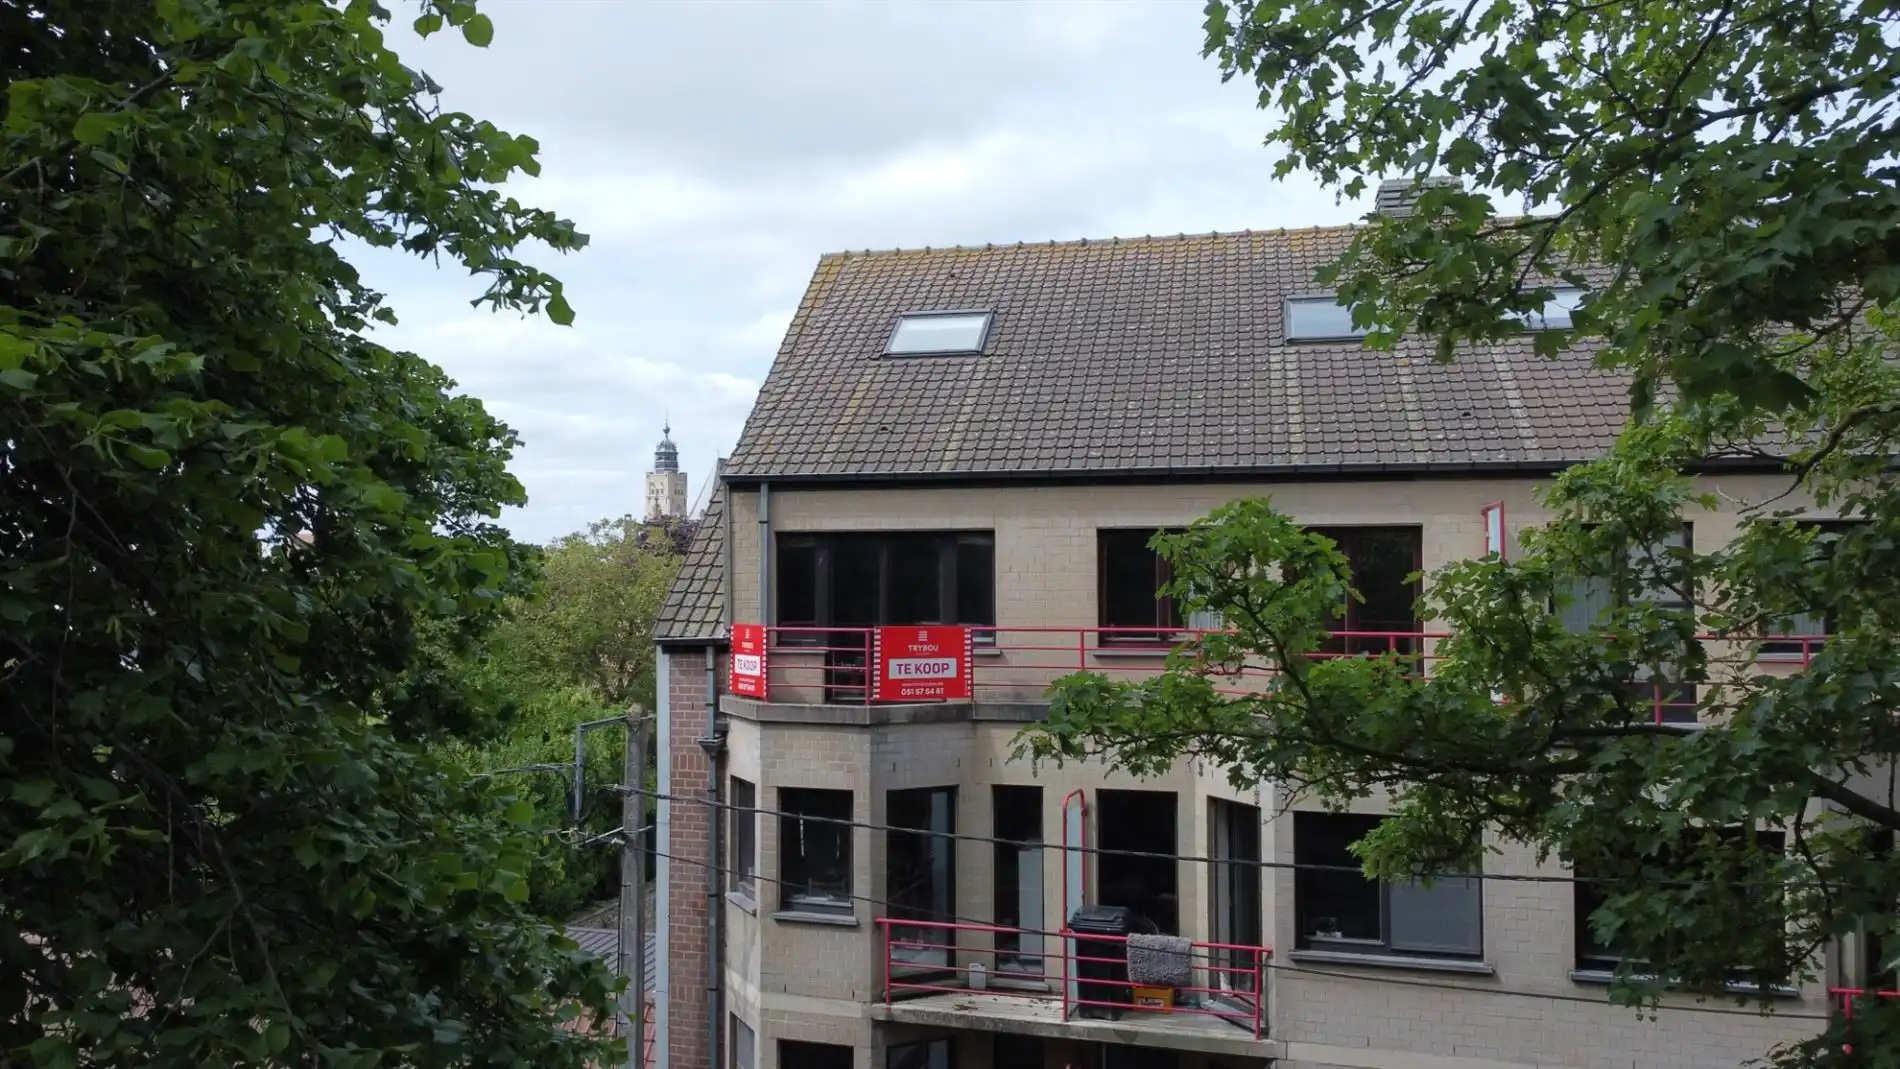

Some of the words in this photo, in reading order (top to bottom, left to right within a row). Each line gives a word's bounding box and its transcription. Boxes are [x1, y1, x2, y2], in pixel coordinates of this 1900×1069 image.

[908, 644, 939, 652] TRYBOU
[896, 663, 912, 675] TE
[915, 662, 950, 675] KOOP
[901, 688, 914, 696] 051
